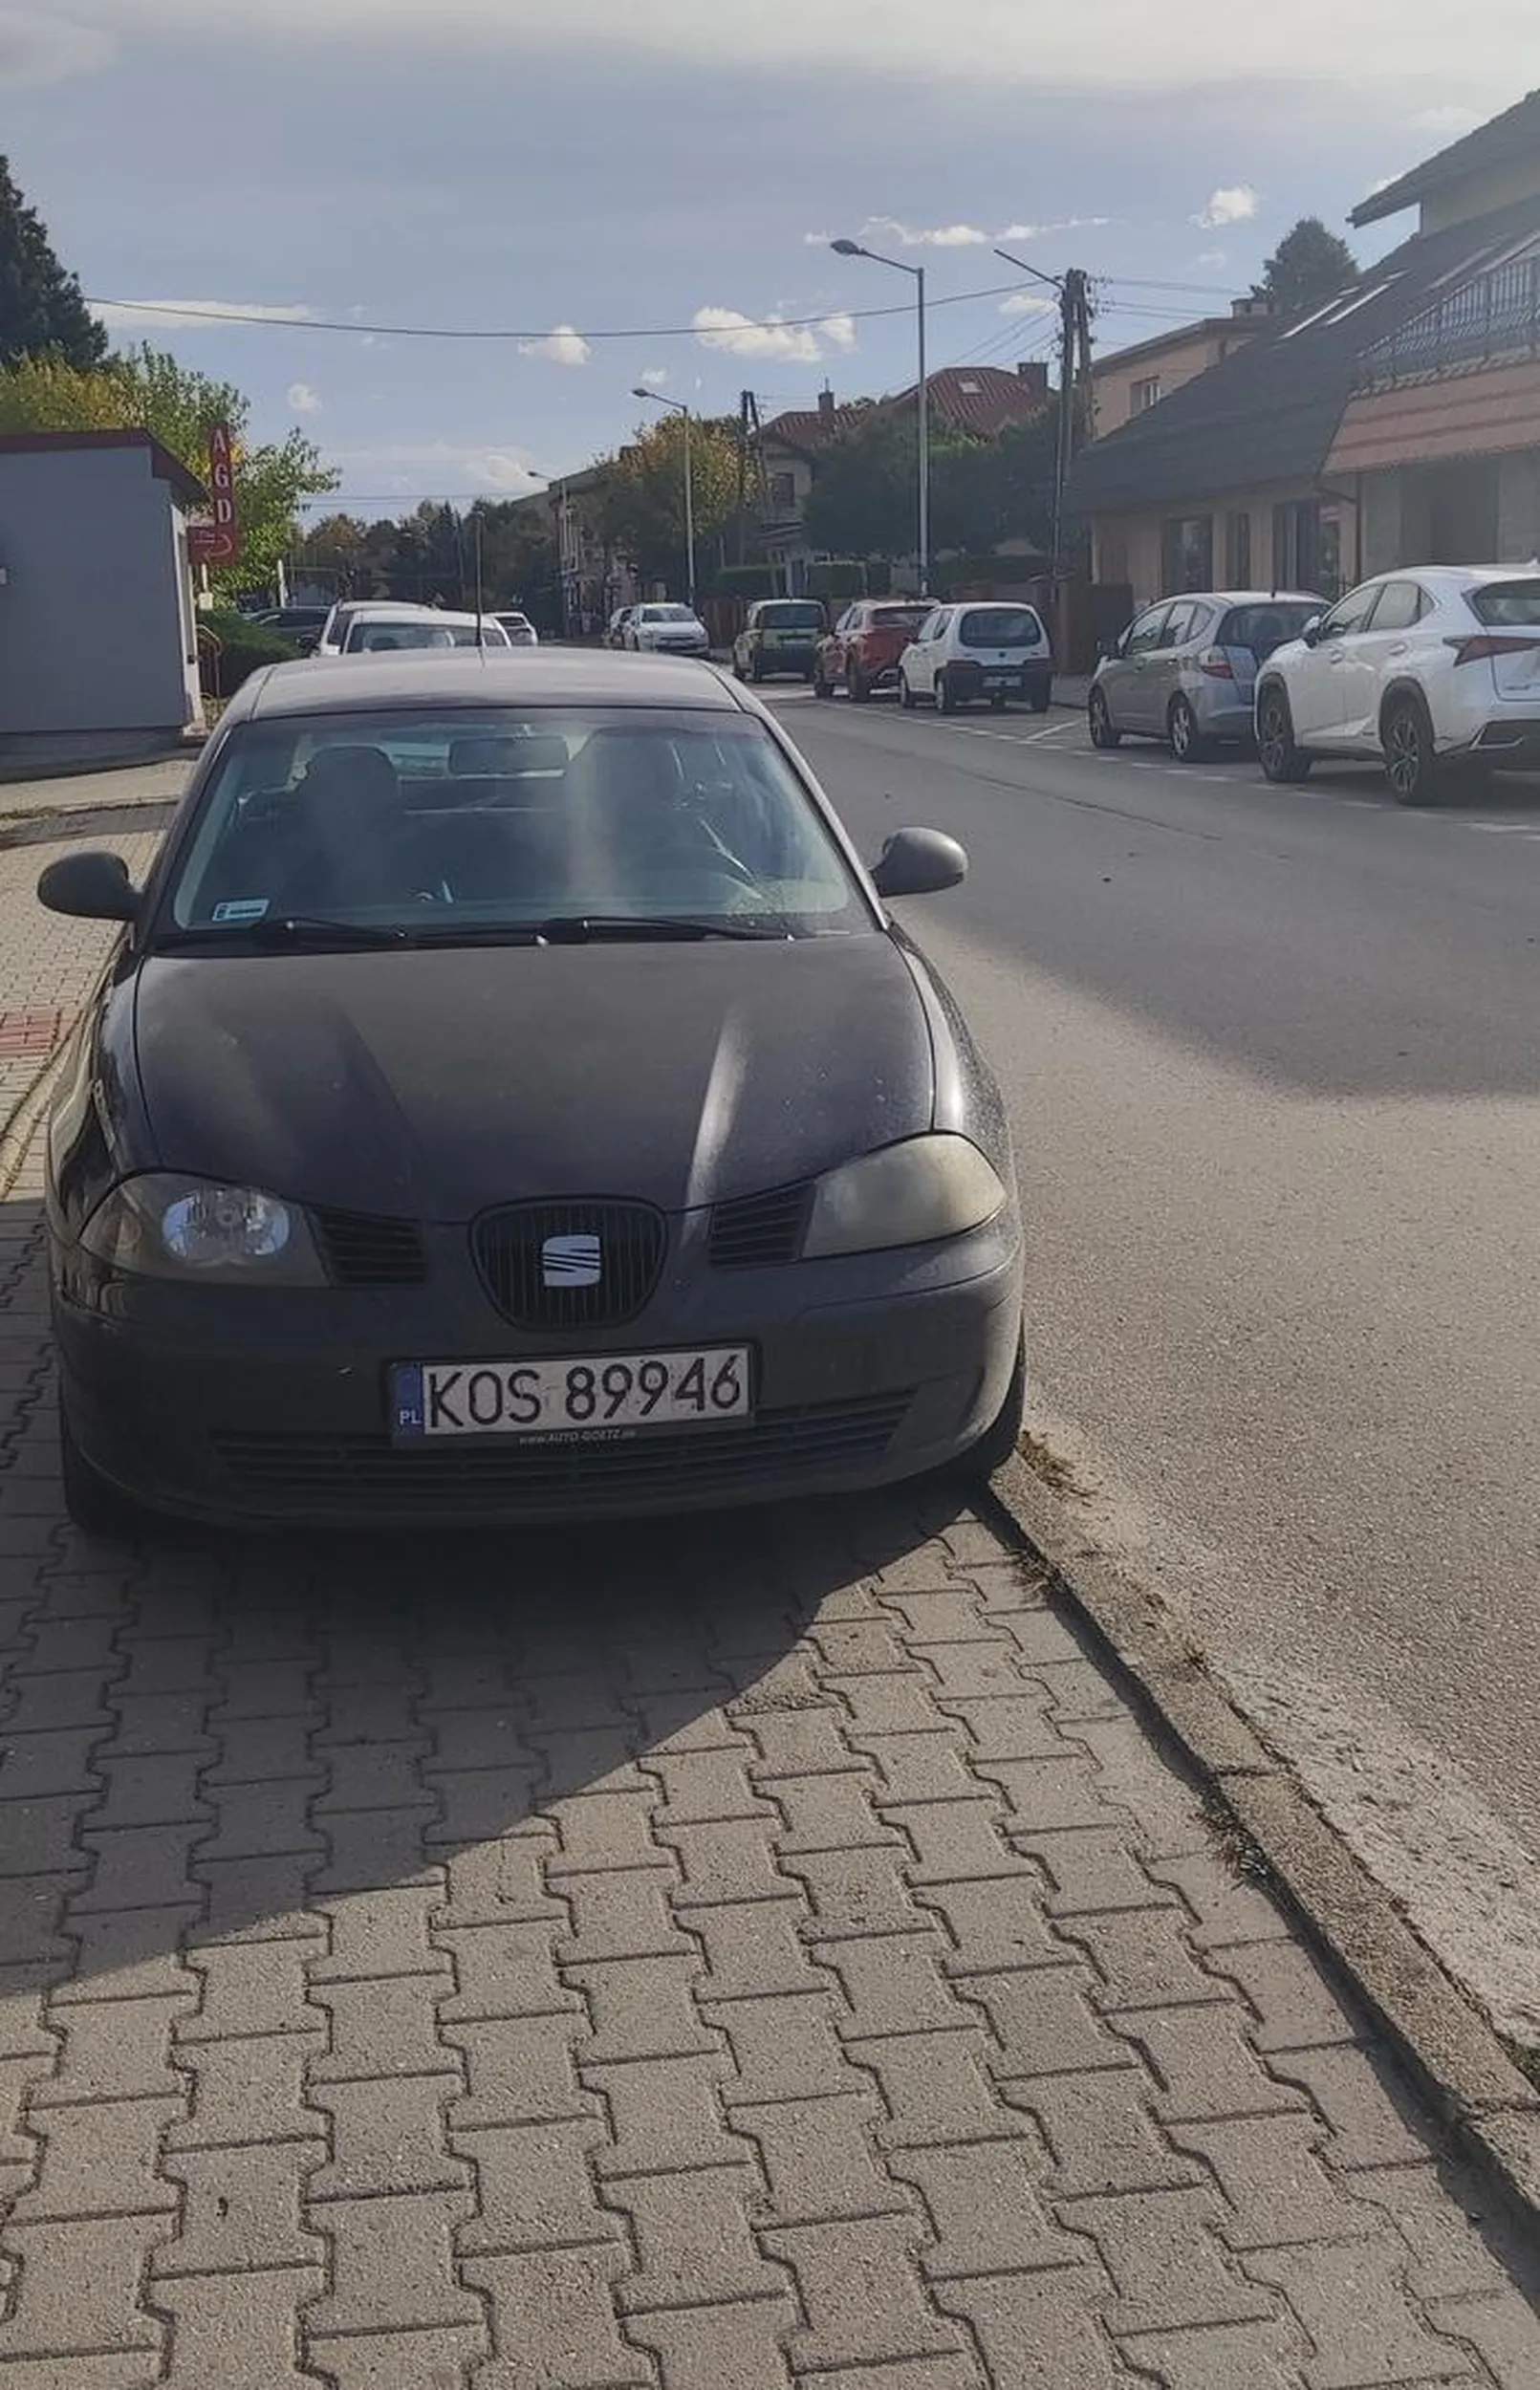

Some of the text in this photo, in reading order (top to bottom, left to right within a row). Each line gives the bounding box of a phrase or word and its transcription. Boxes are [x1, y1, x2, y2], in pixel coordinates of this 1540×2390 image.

[213, 428, 232, 523] AGD
[400, 1411, 422, 1424] PL
[428, 1355, 741, 1428] KOS 89946
